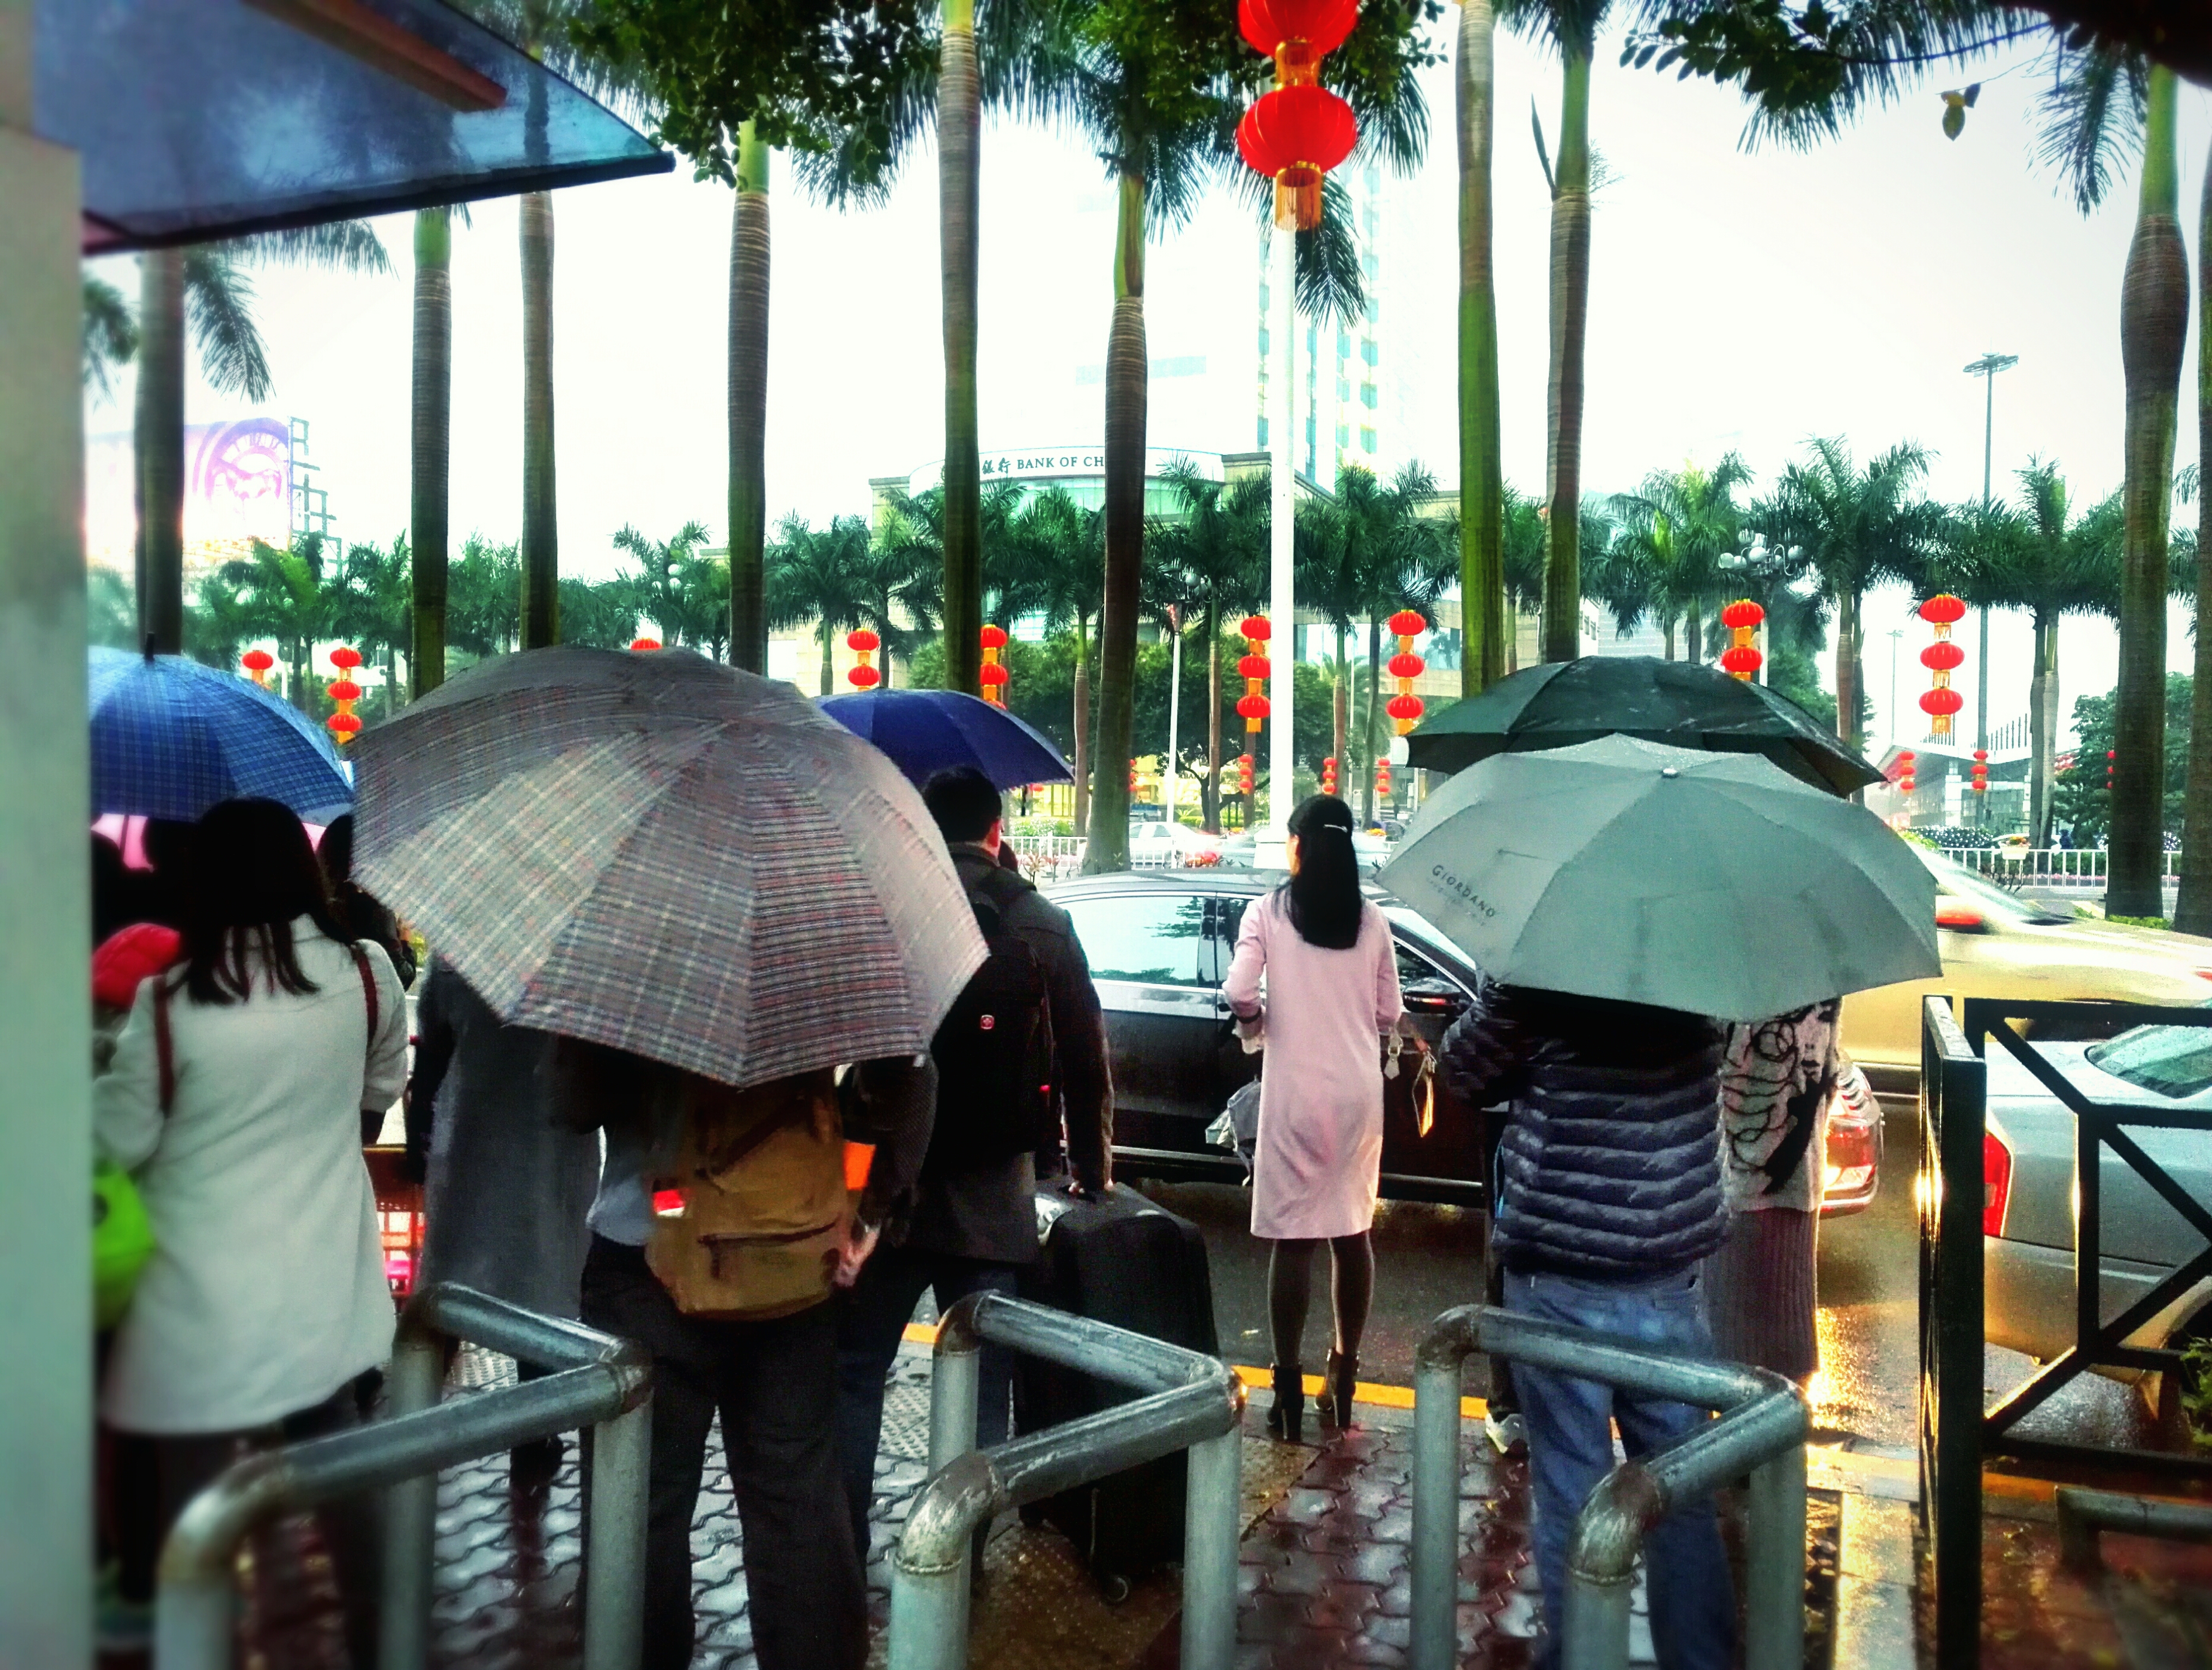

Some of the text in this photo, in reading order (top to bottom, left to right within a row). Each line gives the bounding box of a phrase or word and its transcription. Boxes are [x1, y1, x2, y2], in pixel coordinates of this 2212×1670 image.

[1017, 458, 1055, 469] BANK
[1059, 457, 1078, 467] OF
[1432, 864, 1494, 917] GIORDANO
